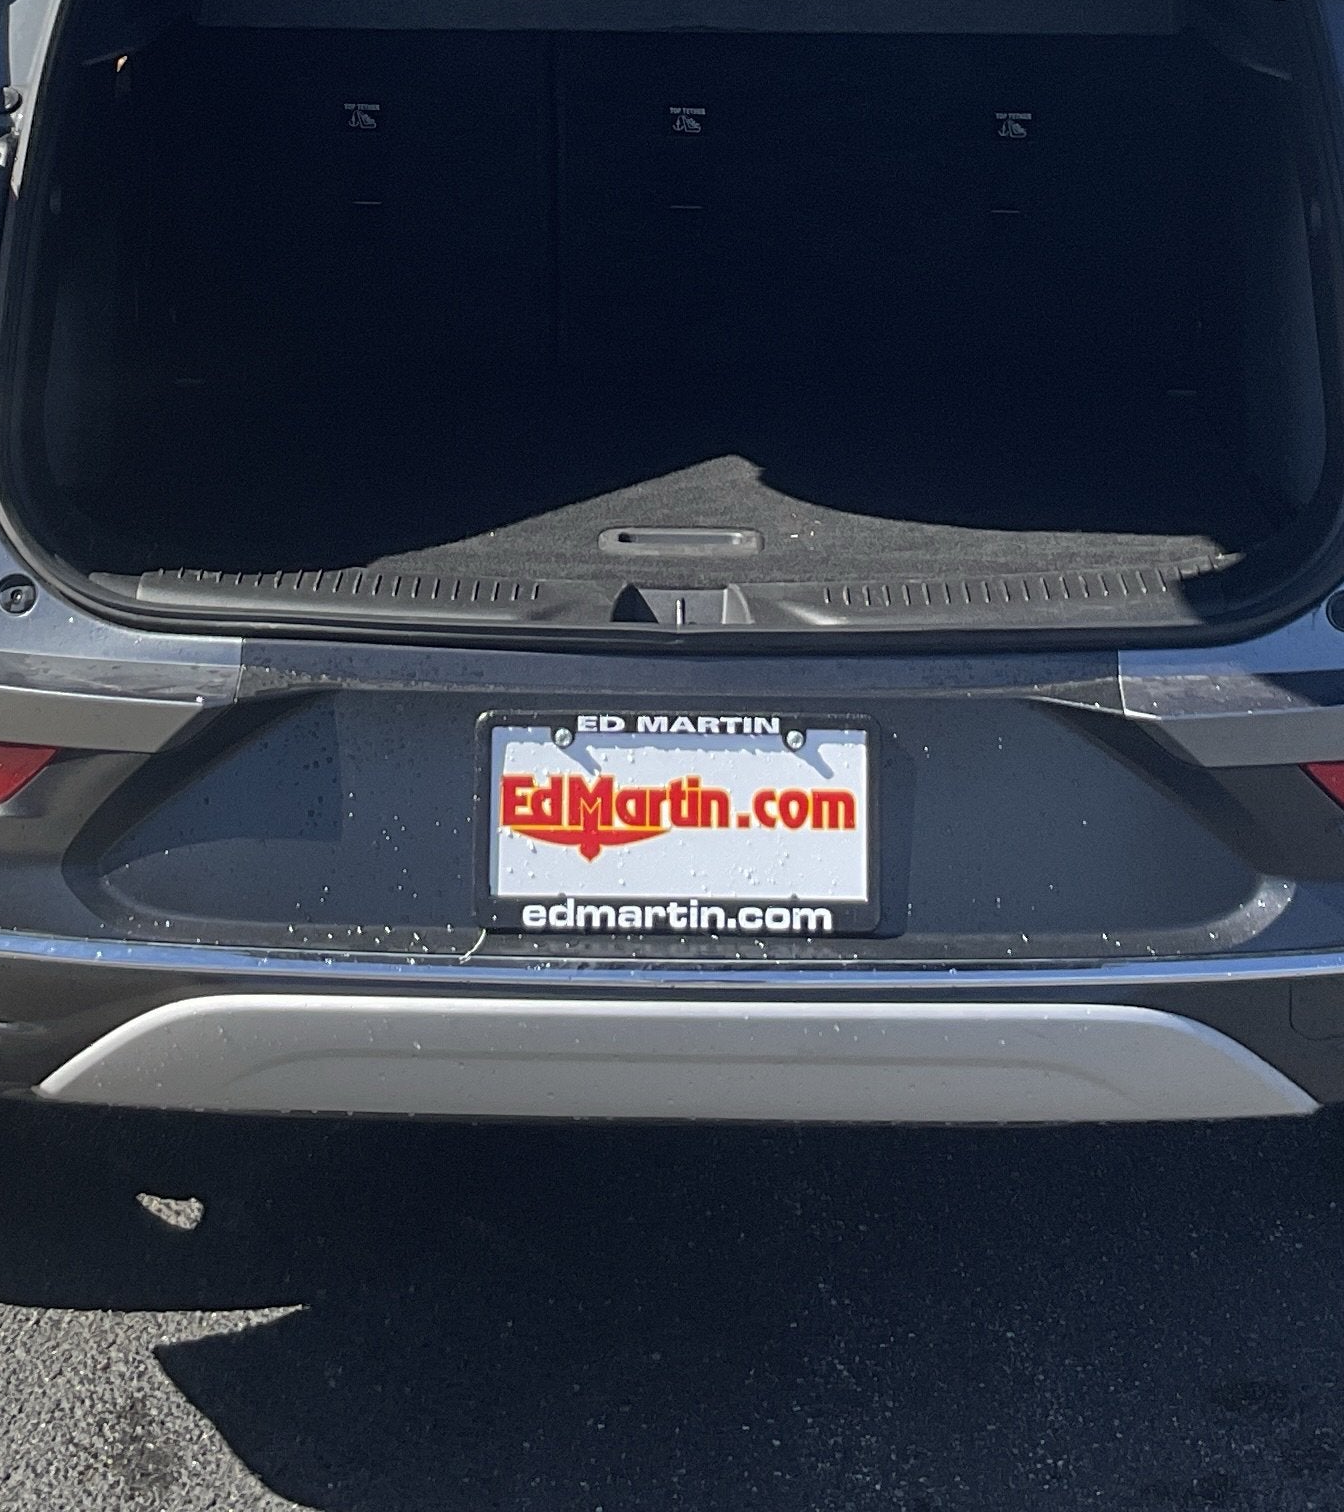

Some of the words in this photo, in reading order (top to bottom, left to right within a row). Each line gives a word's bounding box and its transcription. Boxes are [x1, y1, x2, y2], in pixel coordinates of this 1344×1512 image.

[577, 715, 624, 733] ED
[637, 716, 780, 734] MARTIN
[522, 898, 833, 931] edmartin.com
